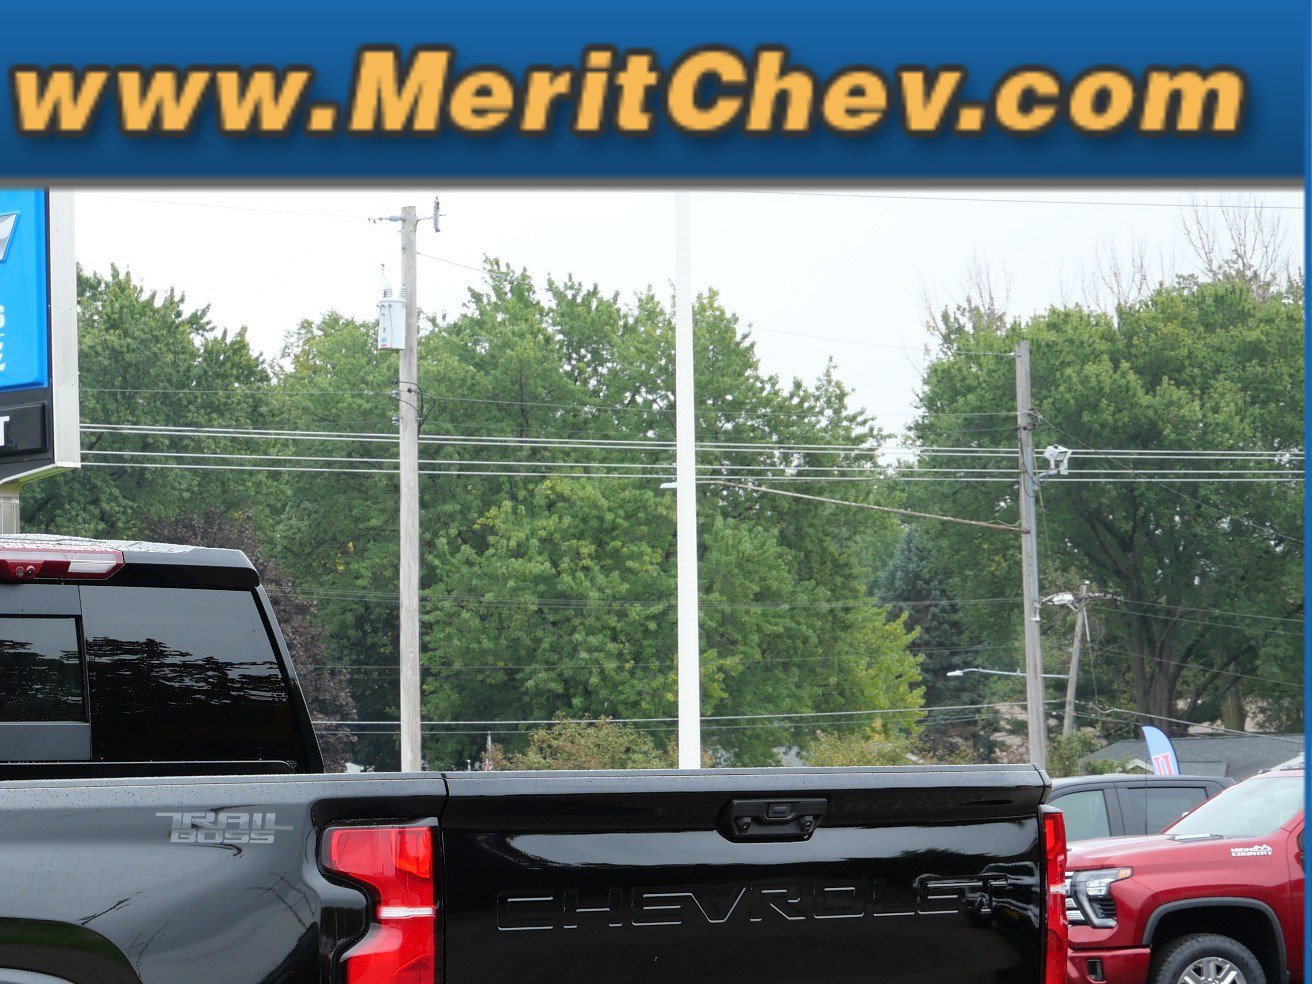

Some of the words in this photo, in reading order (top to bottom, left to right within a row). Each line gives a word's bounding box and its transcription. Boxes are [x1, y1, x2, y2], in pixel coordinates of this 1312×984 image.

[156, 812, 293, 831] TRAIL
[170, 829, 275, 844] BOSS
[496, 873, 1010, 931] CHEVROLET
